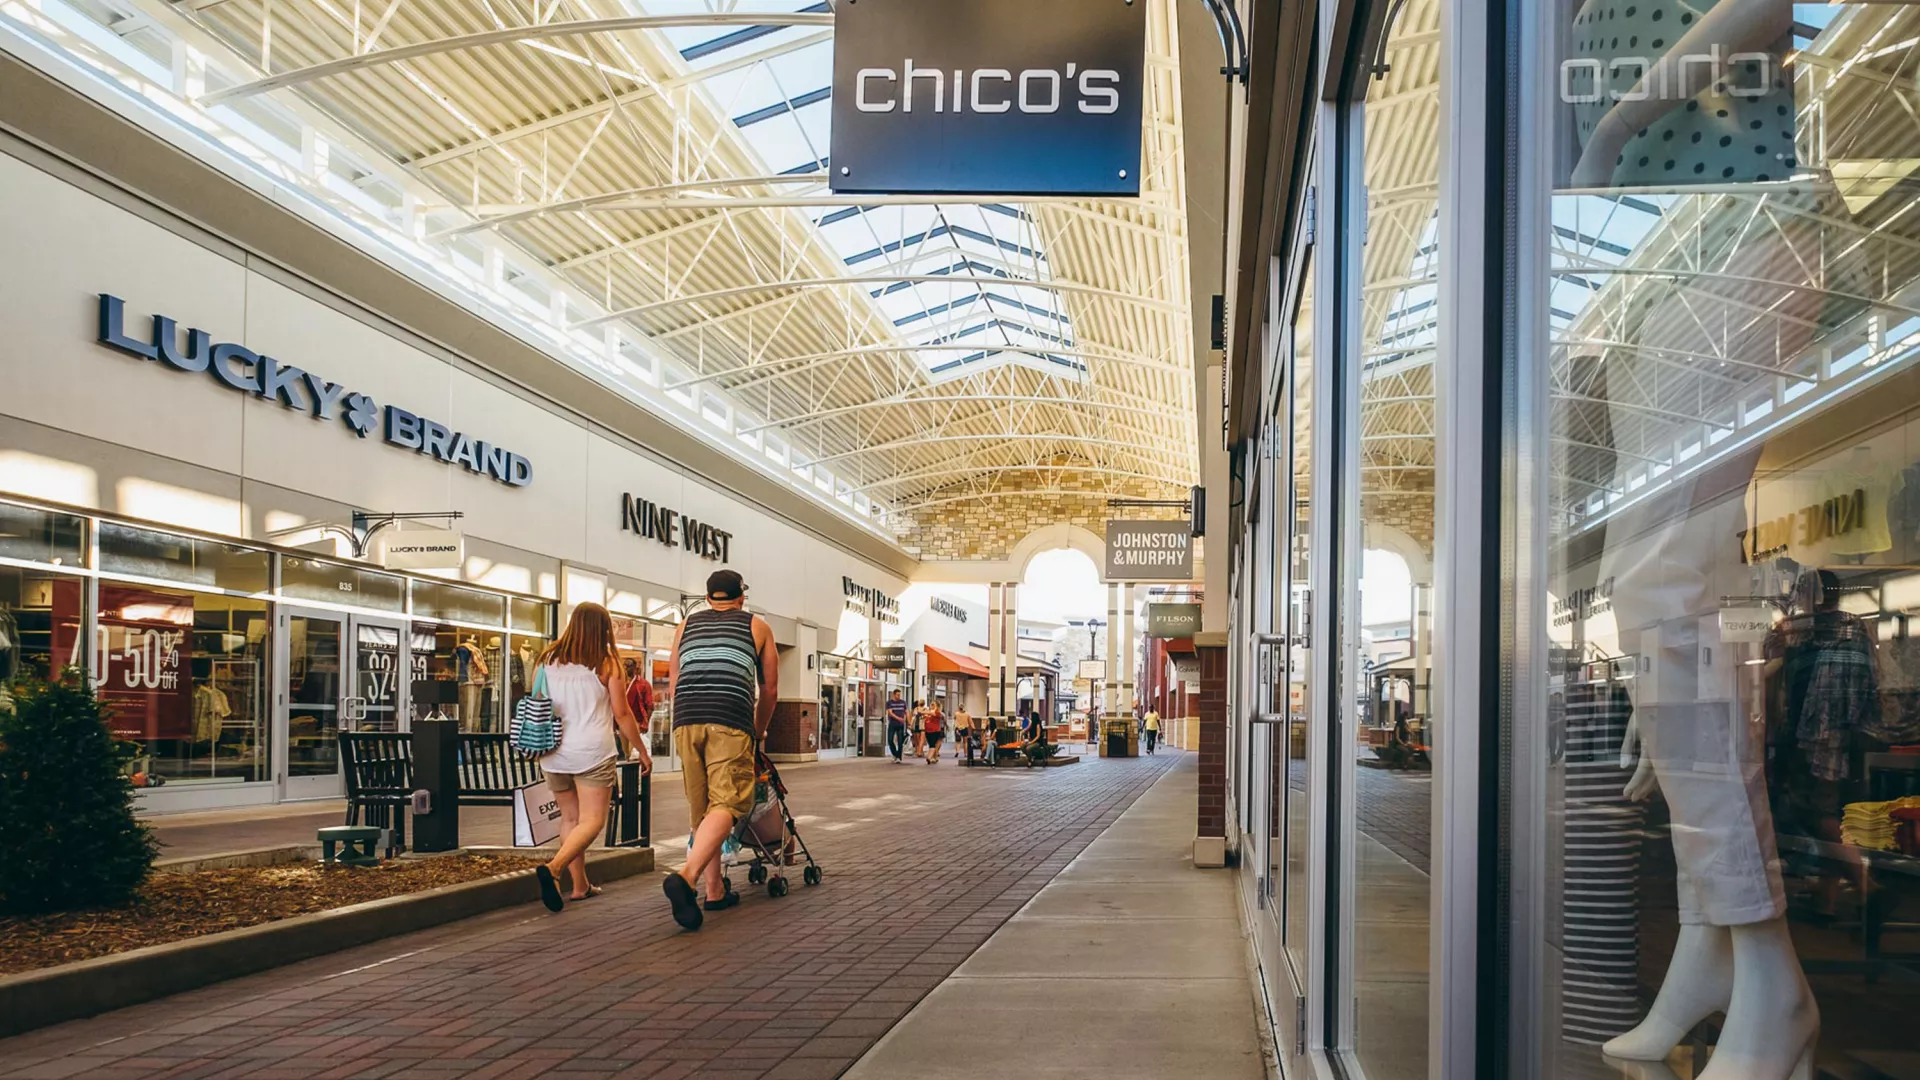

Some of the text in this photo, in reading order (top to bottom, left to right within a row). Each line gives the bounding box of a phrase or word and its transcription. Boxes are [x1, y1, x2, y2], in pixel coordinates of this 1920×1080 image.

[855, 59, 1120, 114] chico's
[98, 293, 533, 487] LUCKY BRAND
[622, 492, 733, 563] NINE WEST
[1112, 533, 1187, 548] JOHNSTON
[1113, 550, 1186, 565] &MURPHY
[339, 582, 353, 592] 835
[162, 671, 179, 689] OFF
